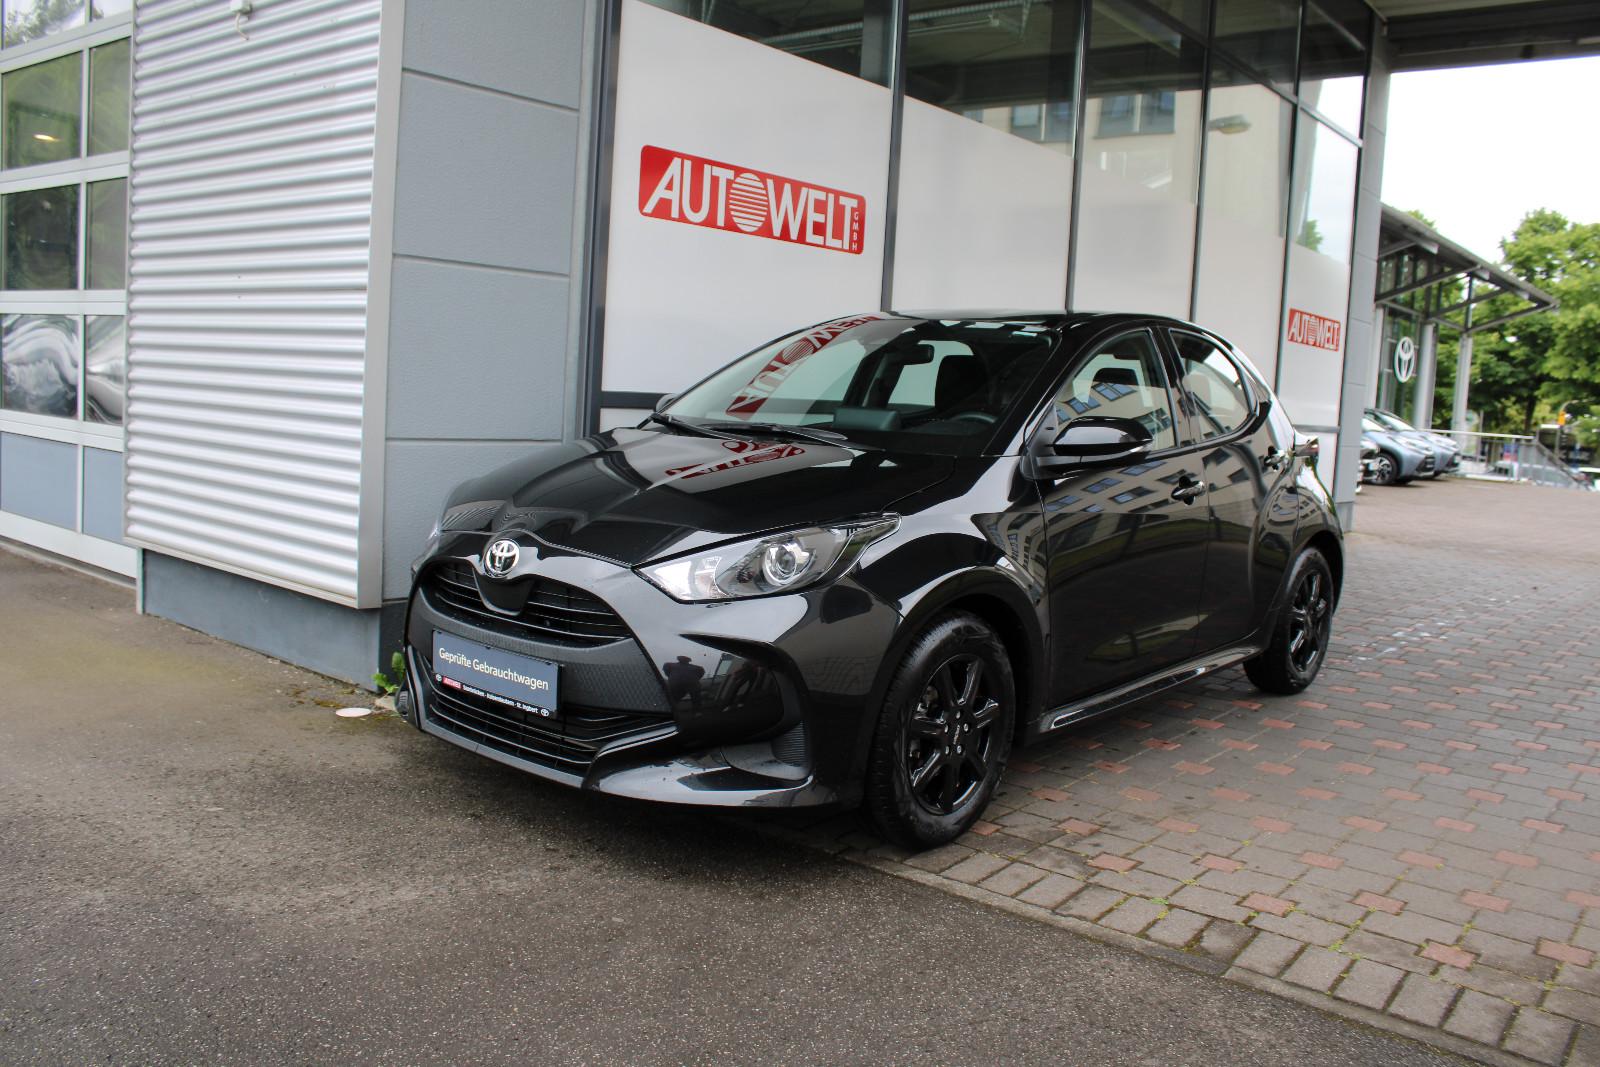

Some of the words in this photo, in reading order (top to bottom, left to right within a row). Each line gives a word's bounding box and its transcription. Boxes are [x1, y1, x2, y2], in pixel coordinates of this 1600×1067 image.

[642, 157, 858, 250] AUTOWELT
[1289, 312, 1338, 350] AUTOWELT
[439, 647, 472, 668] Geprüfte
[472, 659, 549, 691] Gebrauchtwagen
